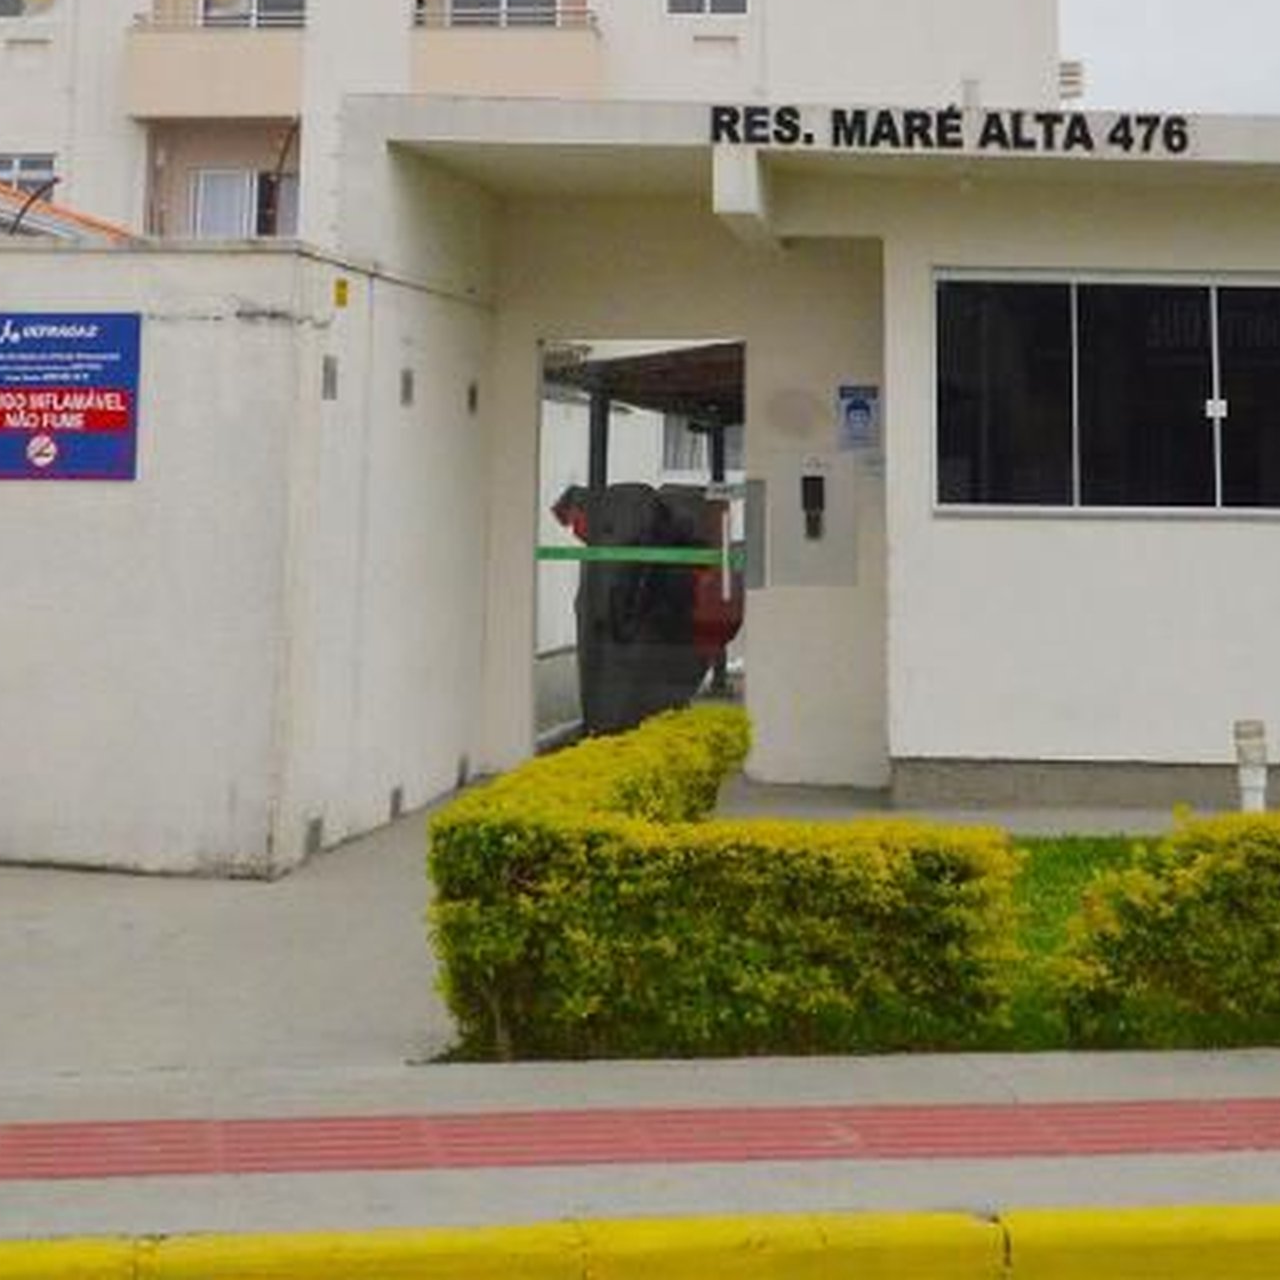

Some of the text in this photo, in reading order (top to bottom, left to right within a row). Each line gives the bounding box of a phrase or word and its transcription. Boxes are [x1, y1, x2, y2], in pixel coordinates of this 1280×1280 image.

[711, 102, 1189, 154] RES. MARÉ ALTA 476
